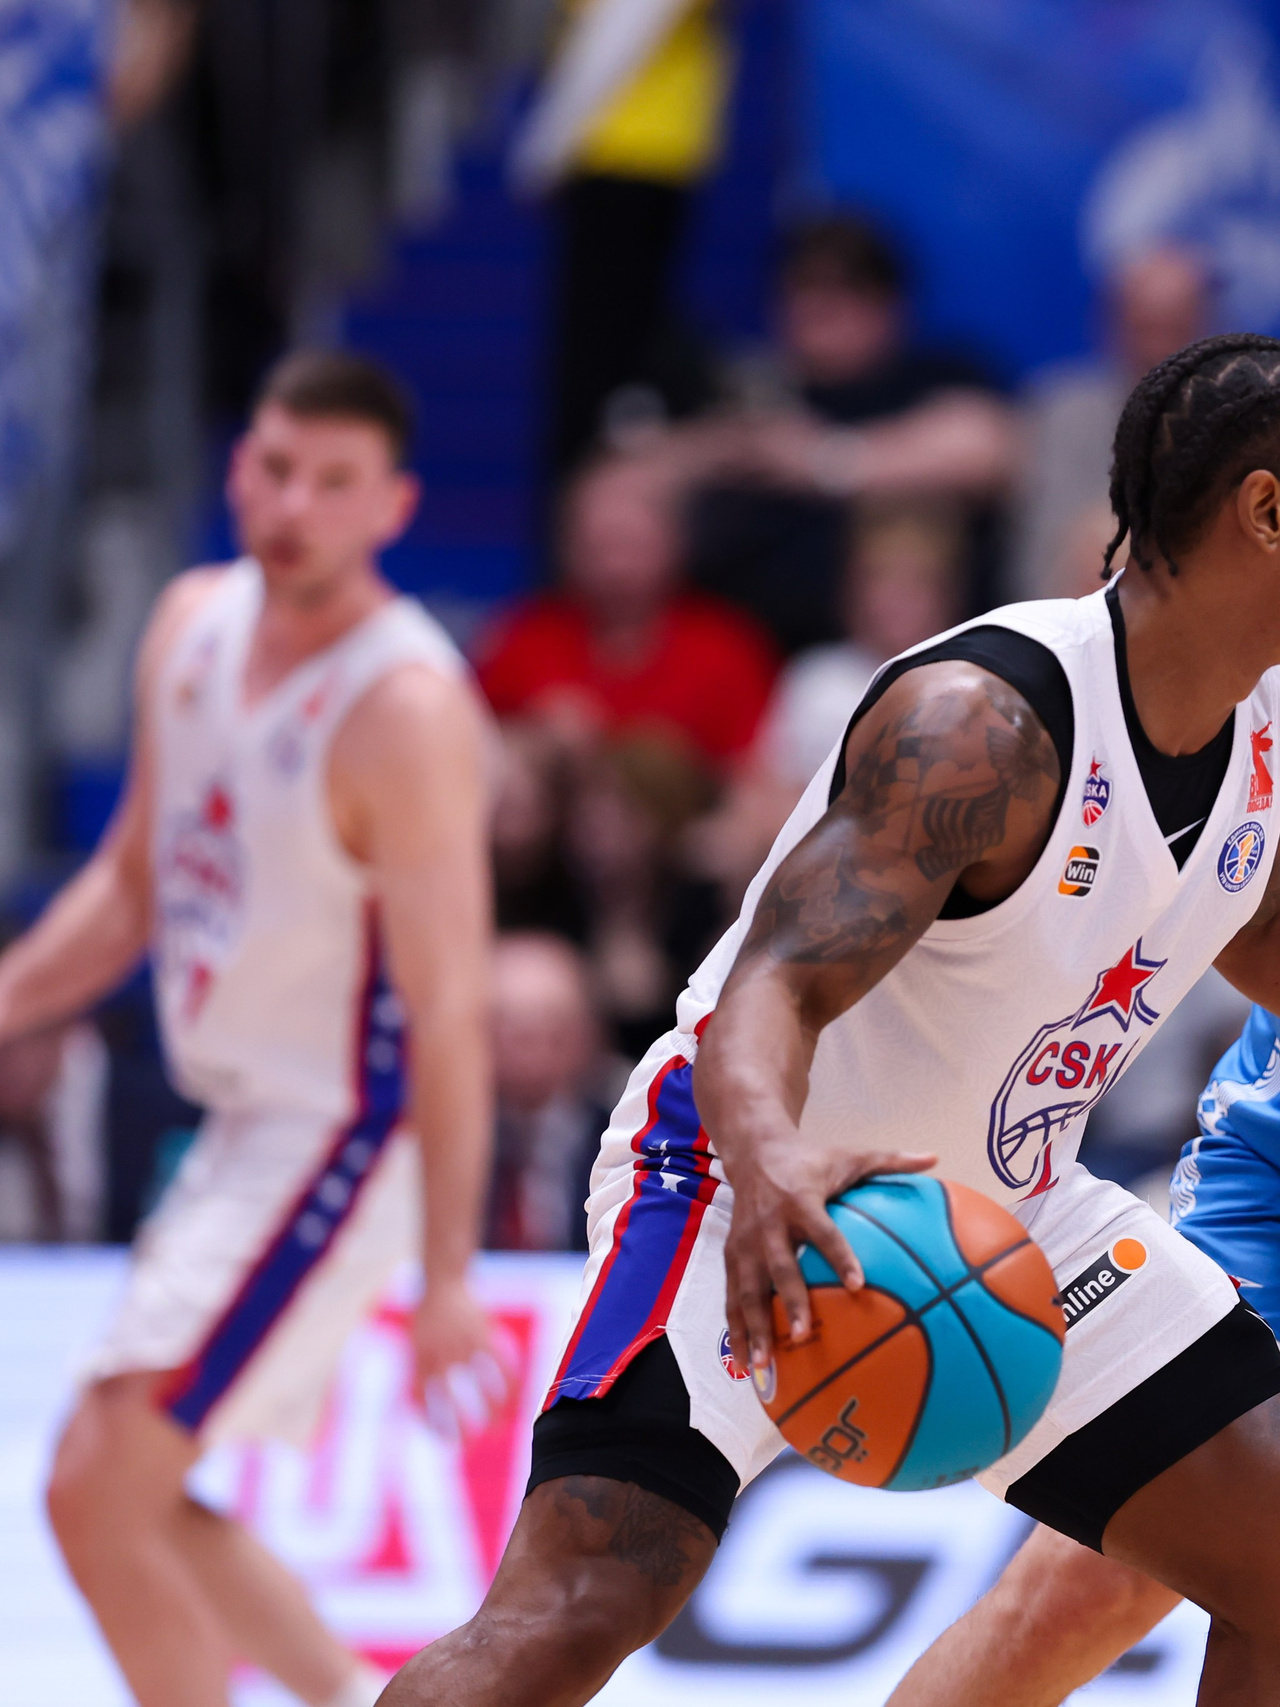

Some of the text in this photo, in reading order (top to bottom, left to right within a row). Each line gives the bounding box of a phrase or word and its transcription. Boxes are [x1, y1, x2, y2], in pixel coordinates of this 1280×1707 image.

[1085, 783, 1107, 798] SKA
[1067, 863, 1095, 881] Win
[1026, 1040, 1123, 1089] CSK
[1062, 1269, 1116, 1323] nline
